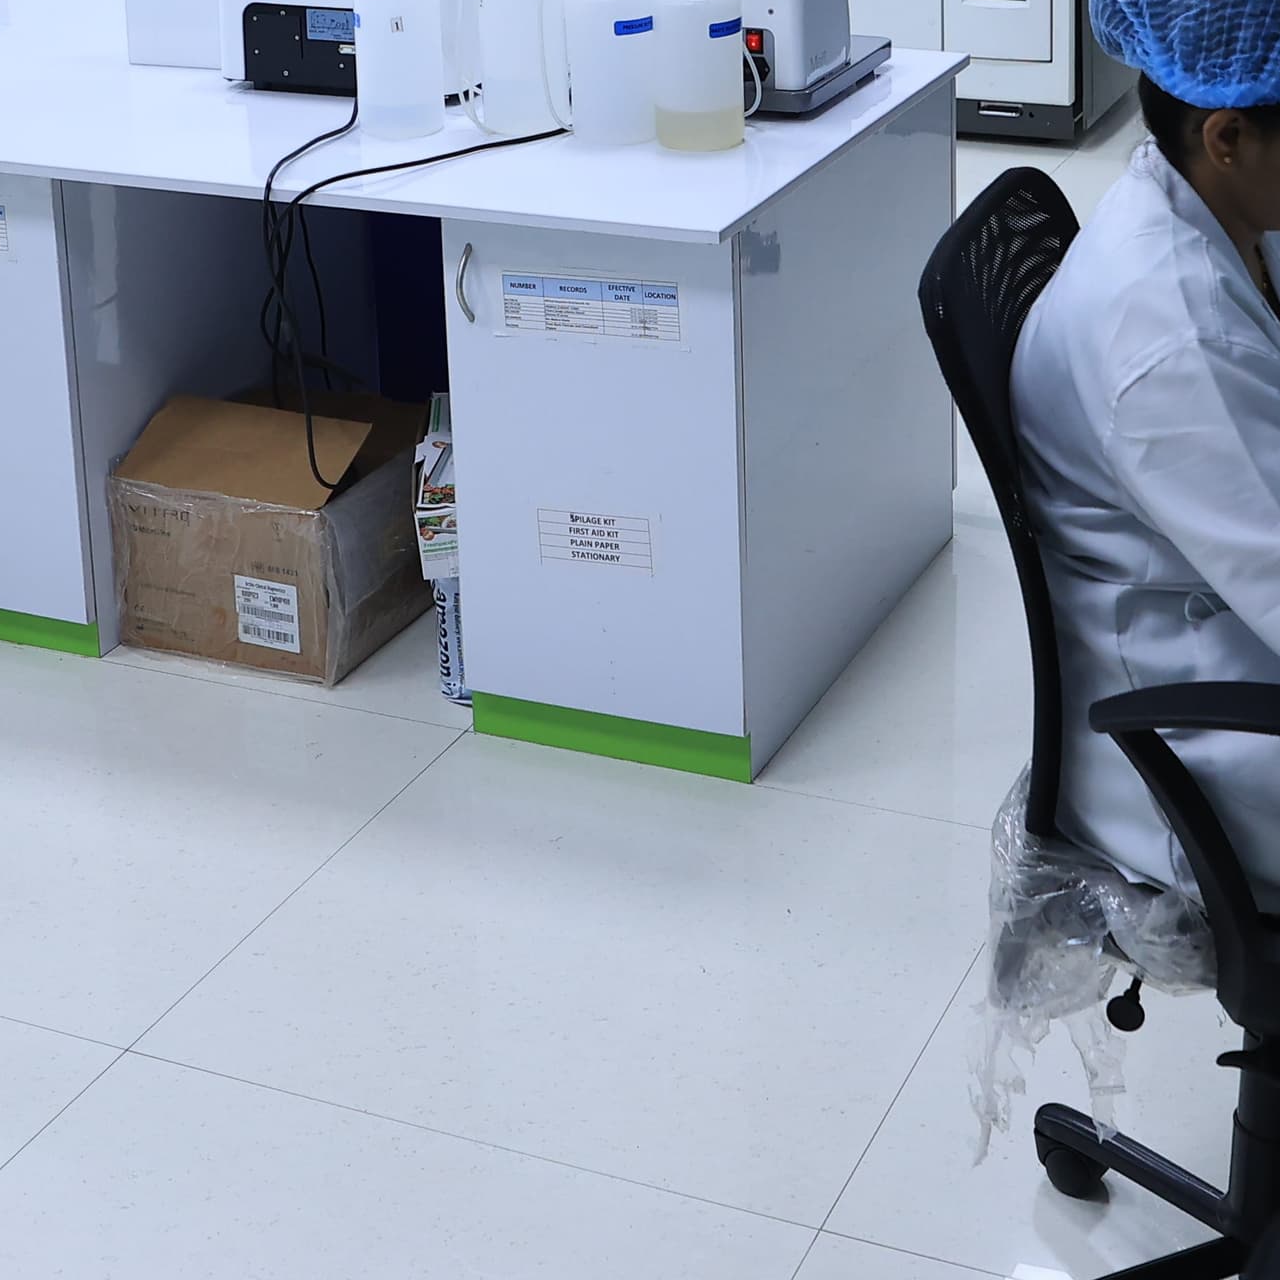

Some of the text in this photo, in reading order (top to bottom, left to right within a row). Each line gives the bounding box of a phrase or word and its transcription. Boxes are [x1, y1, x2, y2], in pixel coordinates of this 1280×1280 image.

[509, 282, 636, 294] NUMBER RECORDS EFECTIVE
[614, 294, 630, 302] DATE
[644, 292, 677, 301] LOCATION
[569, 513, 616, 526] SPILAGE KIT
[568, 526, 619, 538] FIRST AID KIT
[570, 538, 620, 551] PLAIN PAPER
[571, 550, 621, 563] STATIONARY
